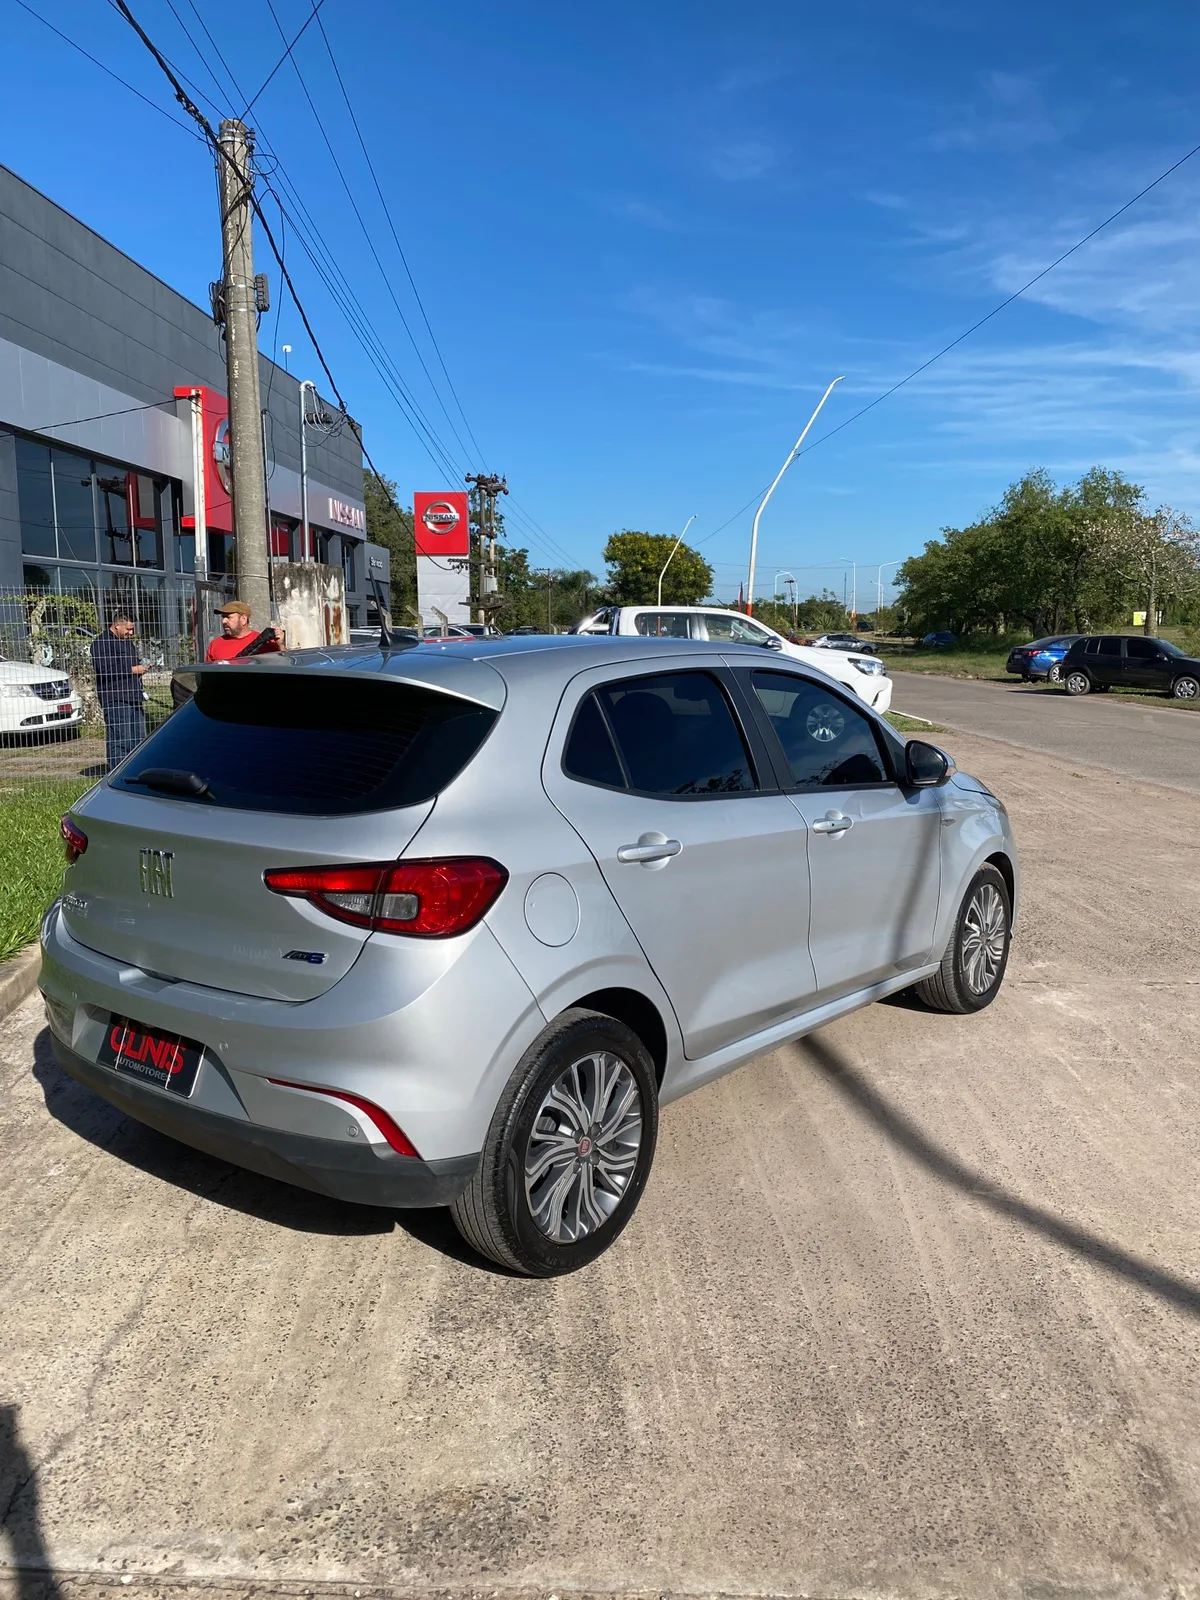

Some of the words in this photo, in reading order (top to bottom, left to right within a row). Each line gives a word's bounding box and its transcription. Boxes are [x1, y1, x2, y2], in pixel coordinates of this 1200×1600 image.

[328, 497, 364, 531] NISSAN
[425, 513, 456, 521] NISSAN
[139, 846, 175, 898] FIAT
[110, 1025, 187, 1074] CLINIS
